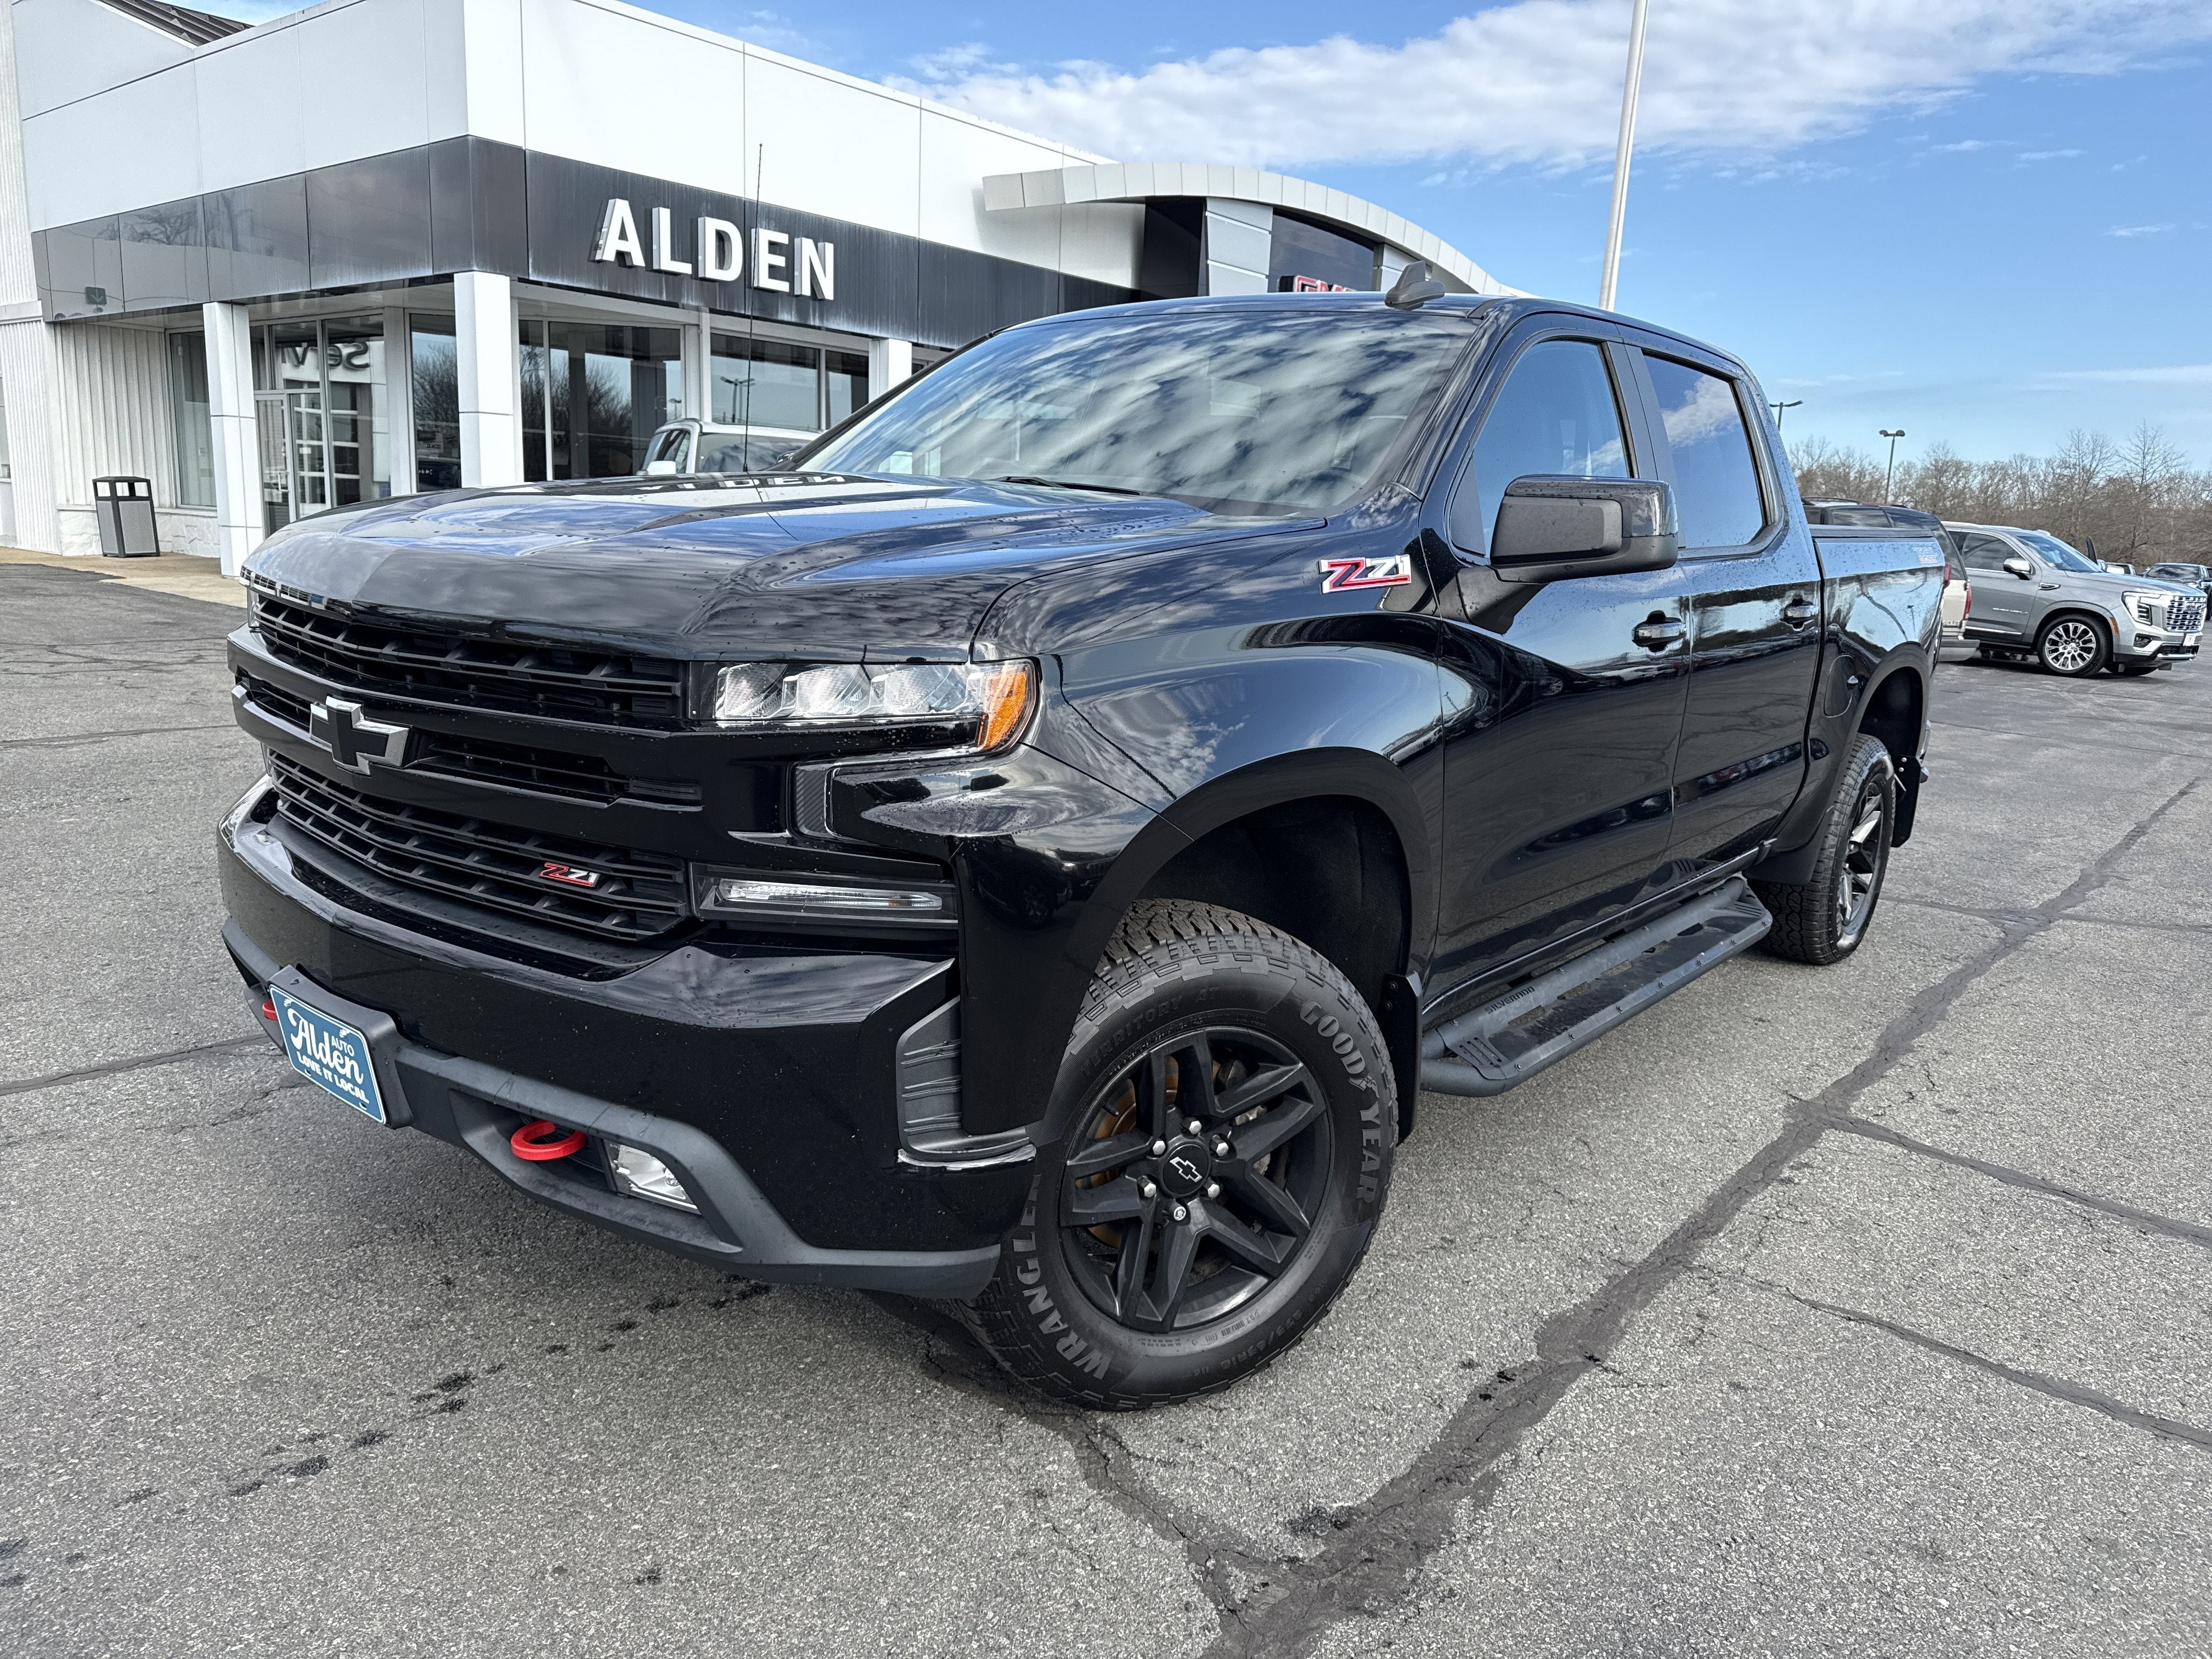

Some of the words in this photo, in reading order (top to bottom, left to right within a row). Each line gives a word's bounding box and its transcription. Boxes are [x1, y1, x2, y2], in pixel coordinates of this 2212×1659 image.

[595, 198, 834, 301] ALDEN
[1319, 554, 1411, 594] Z71
[539, 862, 600, 888] Z71
[1484, 986, 1535, 1014] SILVERADO
[287, 1008, 363, 1084] Alden
[331, 1036, 354, 1057] AUTO
[1079, 995, 1183, 1076] TERRITORY
[297, 1051, 322, 1076] LOVE
[323, 1067, 333, 1082] IT
[334, 1074, 369, 1104] LOCAL
